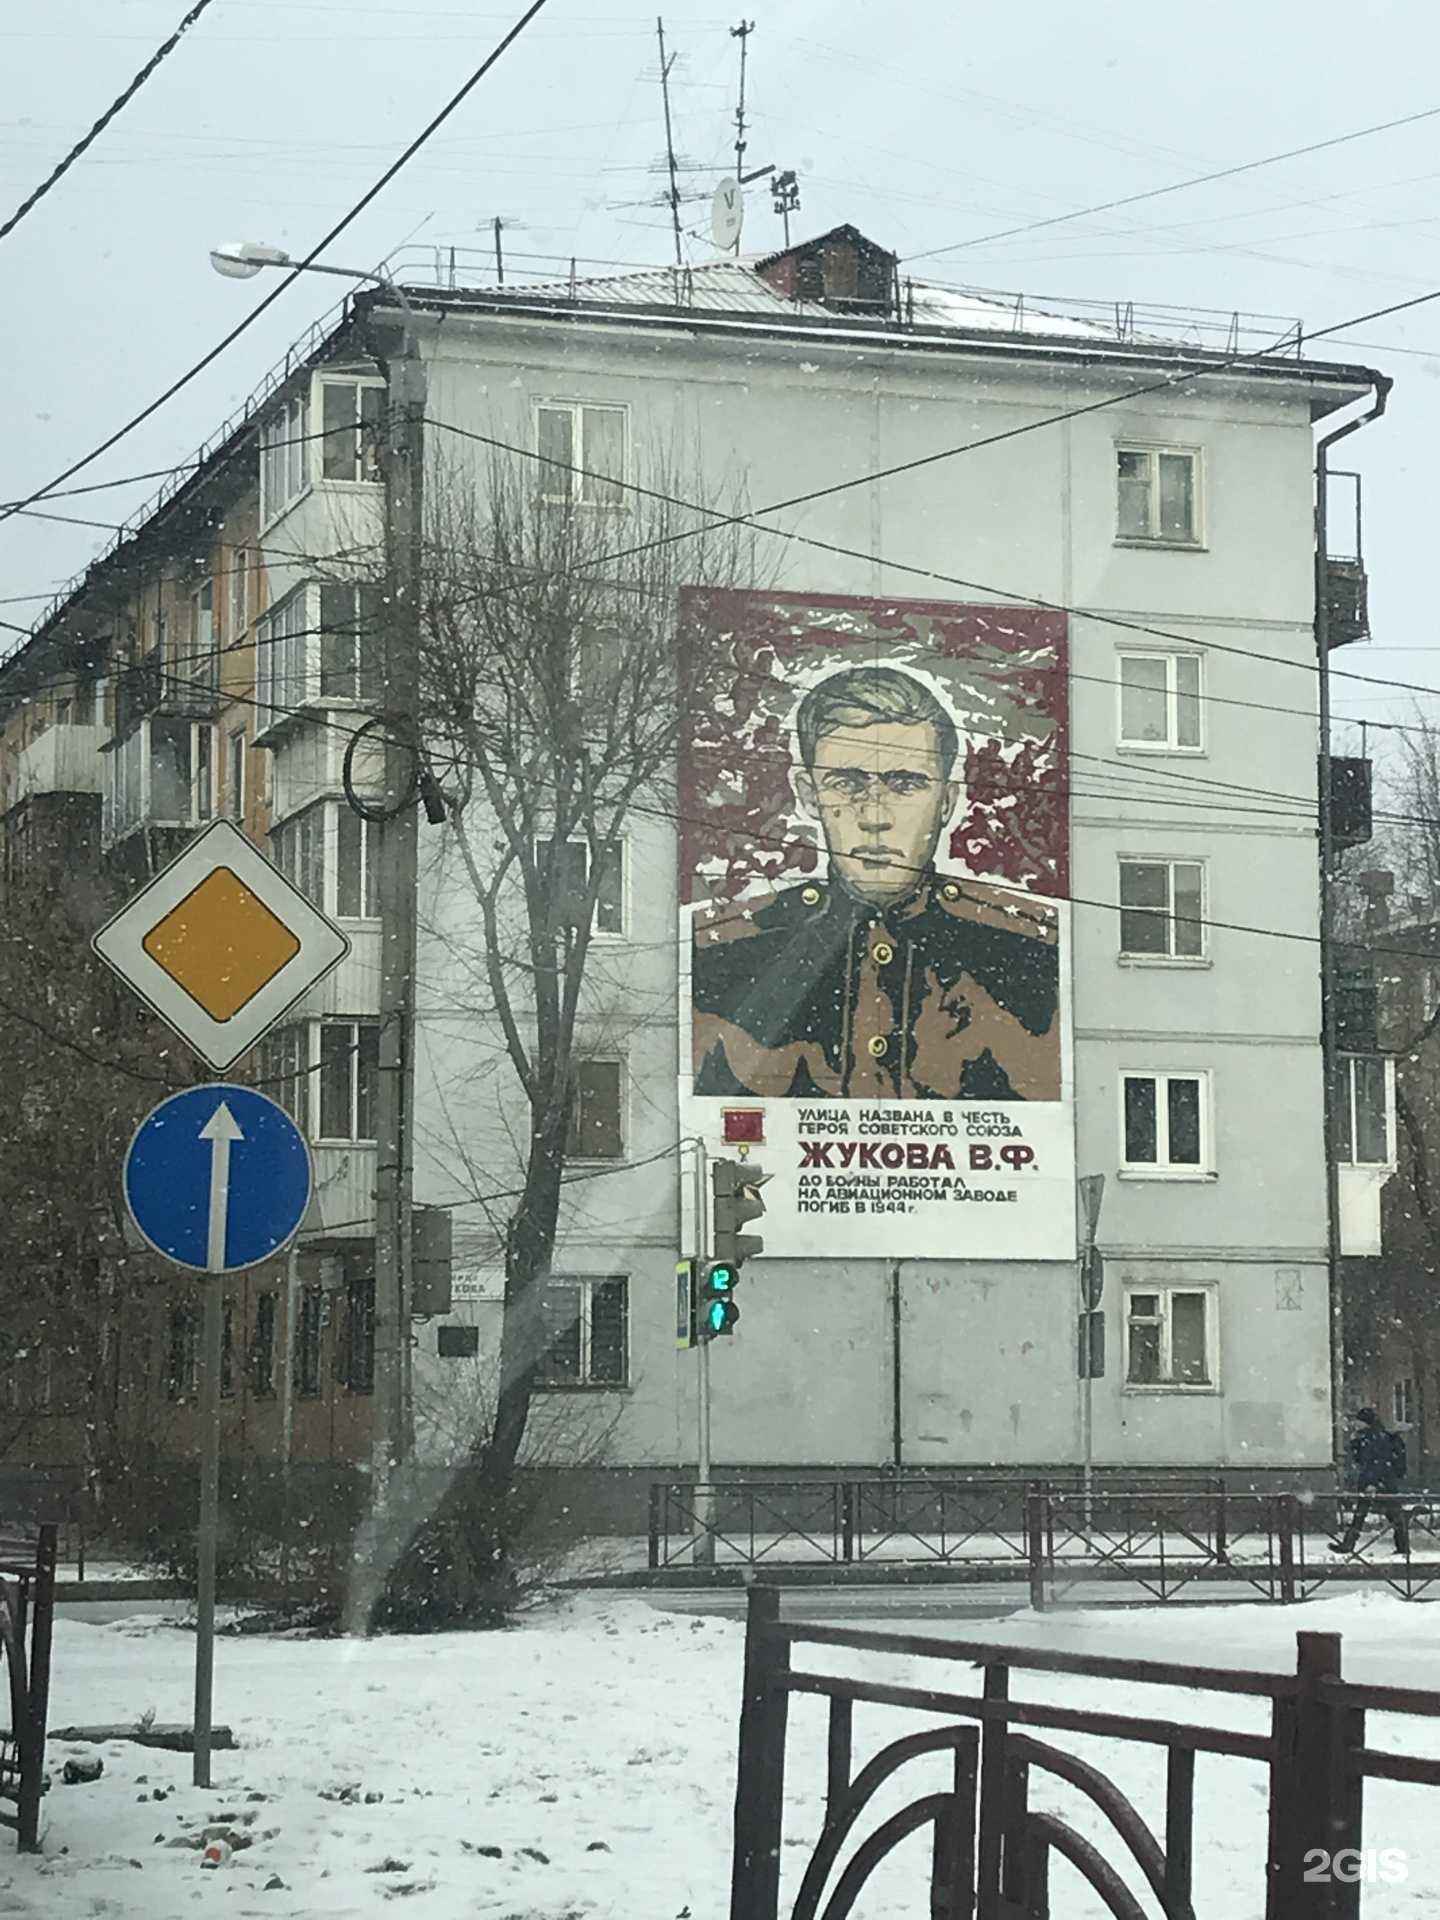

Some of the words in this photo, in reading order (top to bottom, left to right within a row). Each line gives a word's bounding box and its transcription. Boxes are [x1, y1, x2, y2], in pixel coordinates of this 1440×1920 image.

[797, 1108, 851, 1123] УЛИЦА
[859, 1109, 935, 1122] НАЗВАНА
[943, 1110, 953, 1122] В
[961, 1111, 1011, 1124] ЧЕСТЬ
[798, 1122, 849, 1135] ГЕРОЯ
[858, 1123, 958, 1136] СОВЕТСКОГО
[966, 1124, 1023, 1137] СОЮЗА
[797, 1141, 956, 1170] ЖУКОВА
[968, 1143, 1039, 1171] В.Ф.
[798, 1175, 822, 1187] ДО
[887, 1176, 967, 1189] РАБОТАЛ
[798, 1187, 820, 1199] НА
[826, 1188, 947, 1201] АВИАЦИОННОМ
[953, 1189, 1018, 1202] ЗАВОДЕ
[798, 1200, 851, 1214] ПОГИБ
[855, 1201, 867, 1214] В
